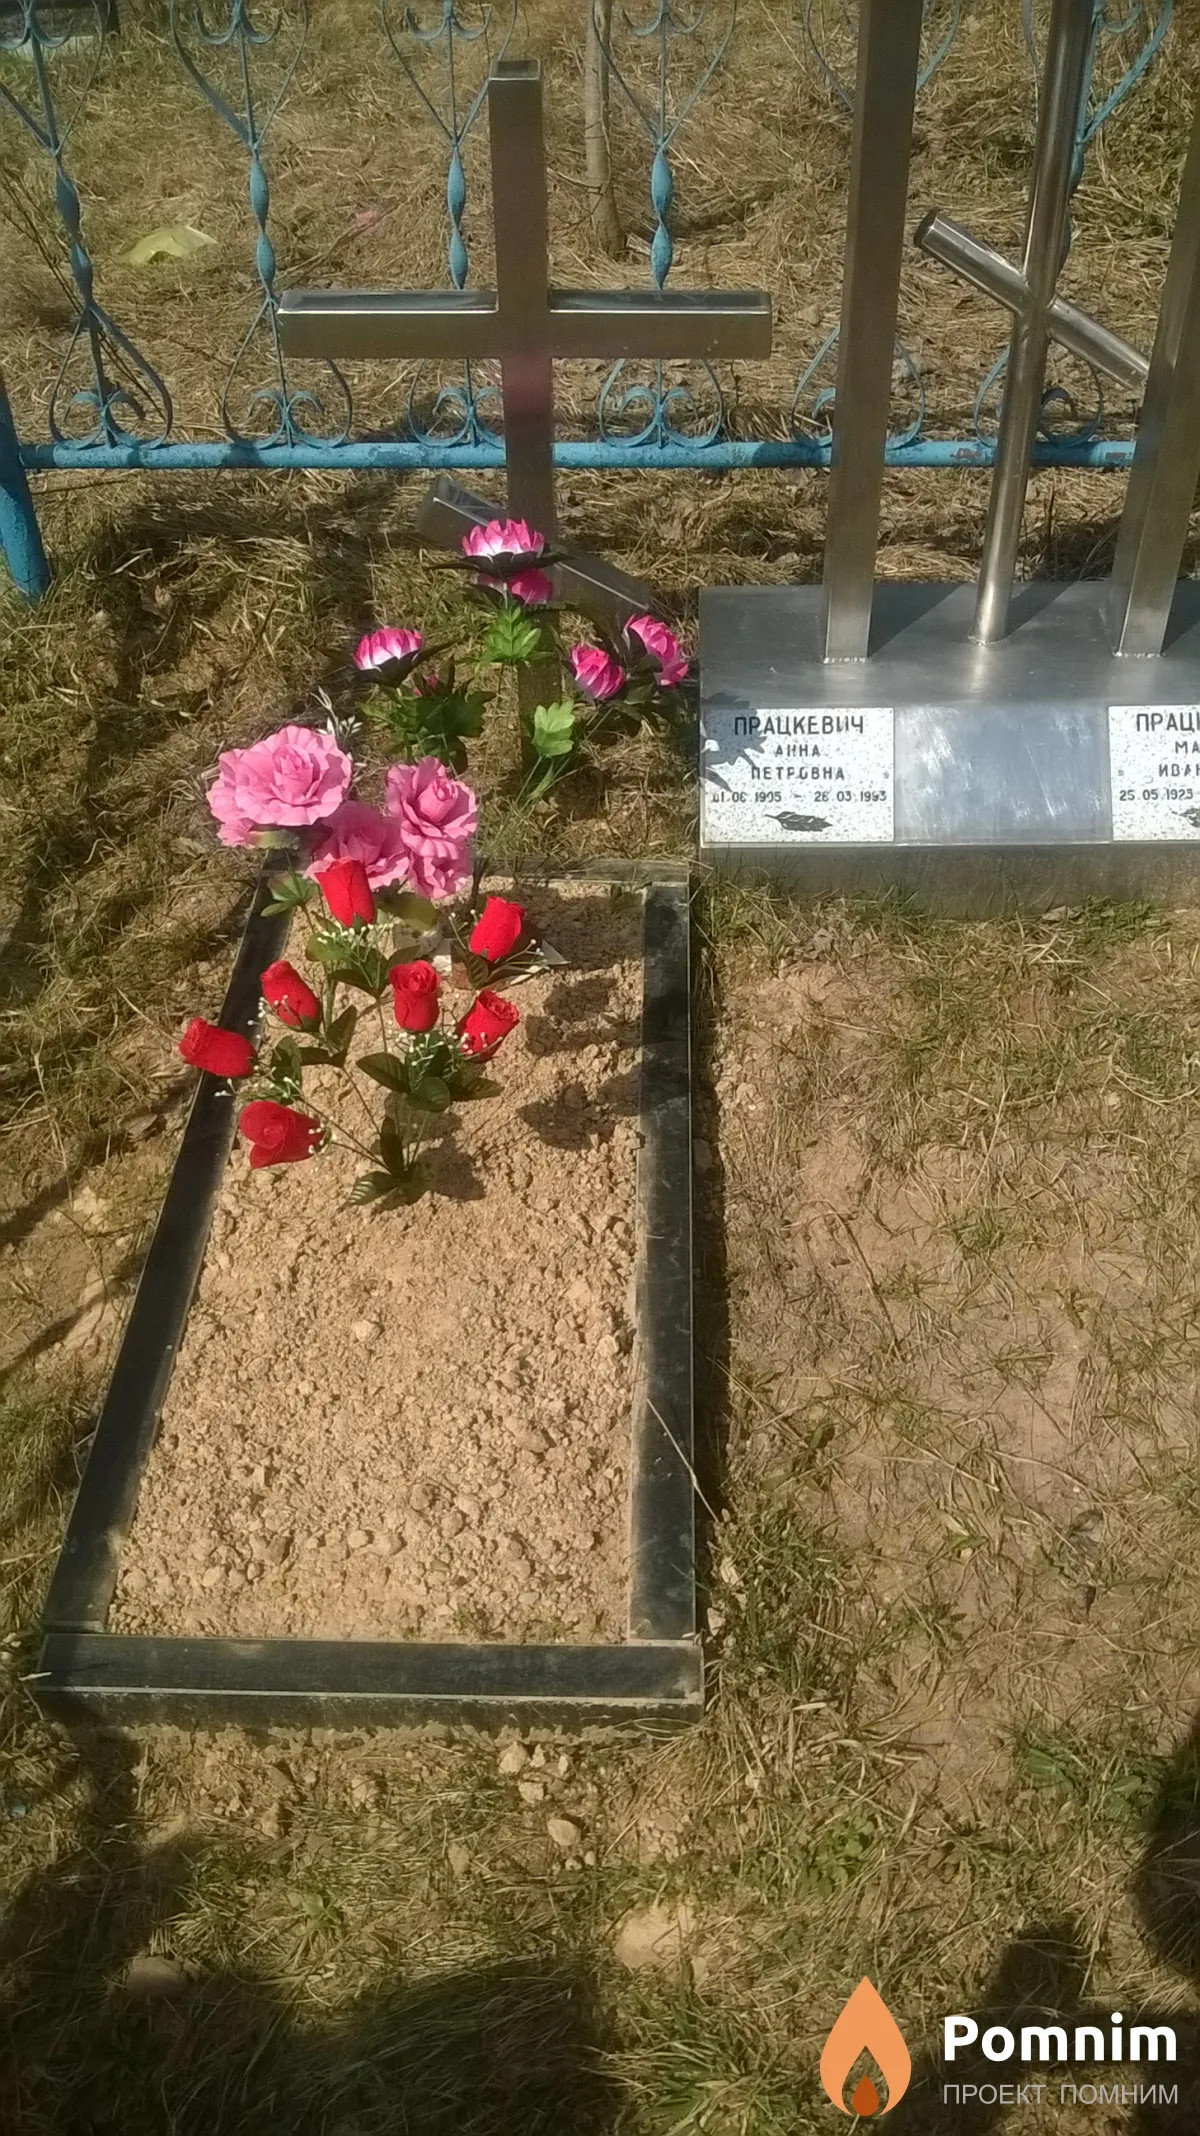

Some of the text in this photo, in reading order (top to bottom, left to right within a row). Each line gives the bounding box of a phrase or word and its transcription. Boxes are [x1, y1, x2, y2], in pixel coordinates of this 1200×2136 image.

[734, 716, 864, 736] ПРАЦКЕВИЧ
[1136, 711, 1200, 733] ПРАЦ
[775, 744, 821, 757] АННА
[751, 766, 845, 780] ПЕТРОВНА
